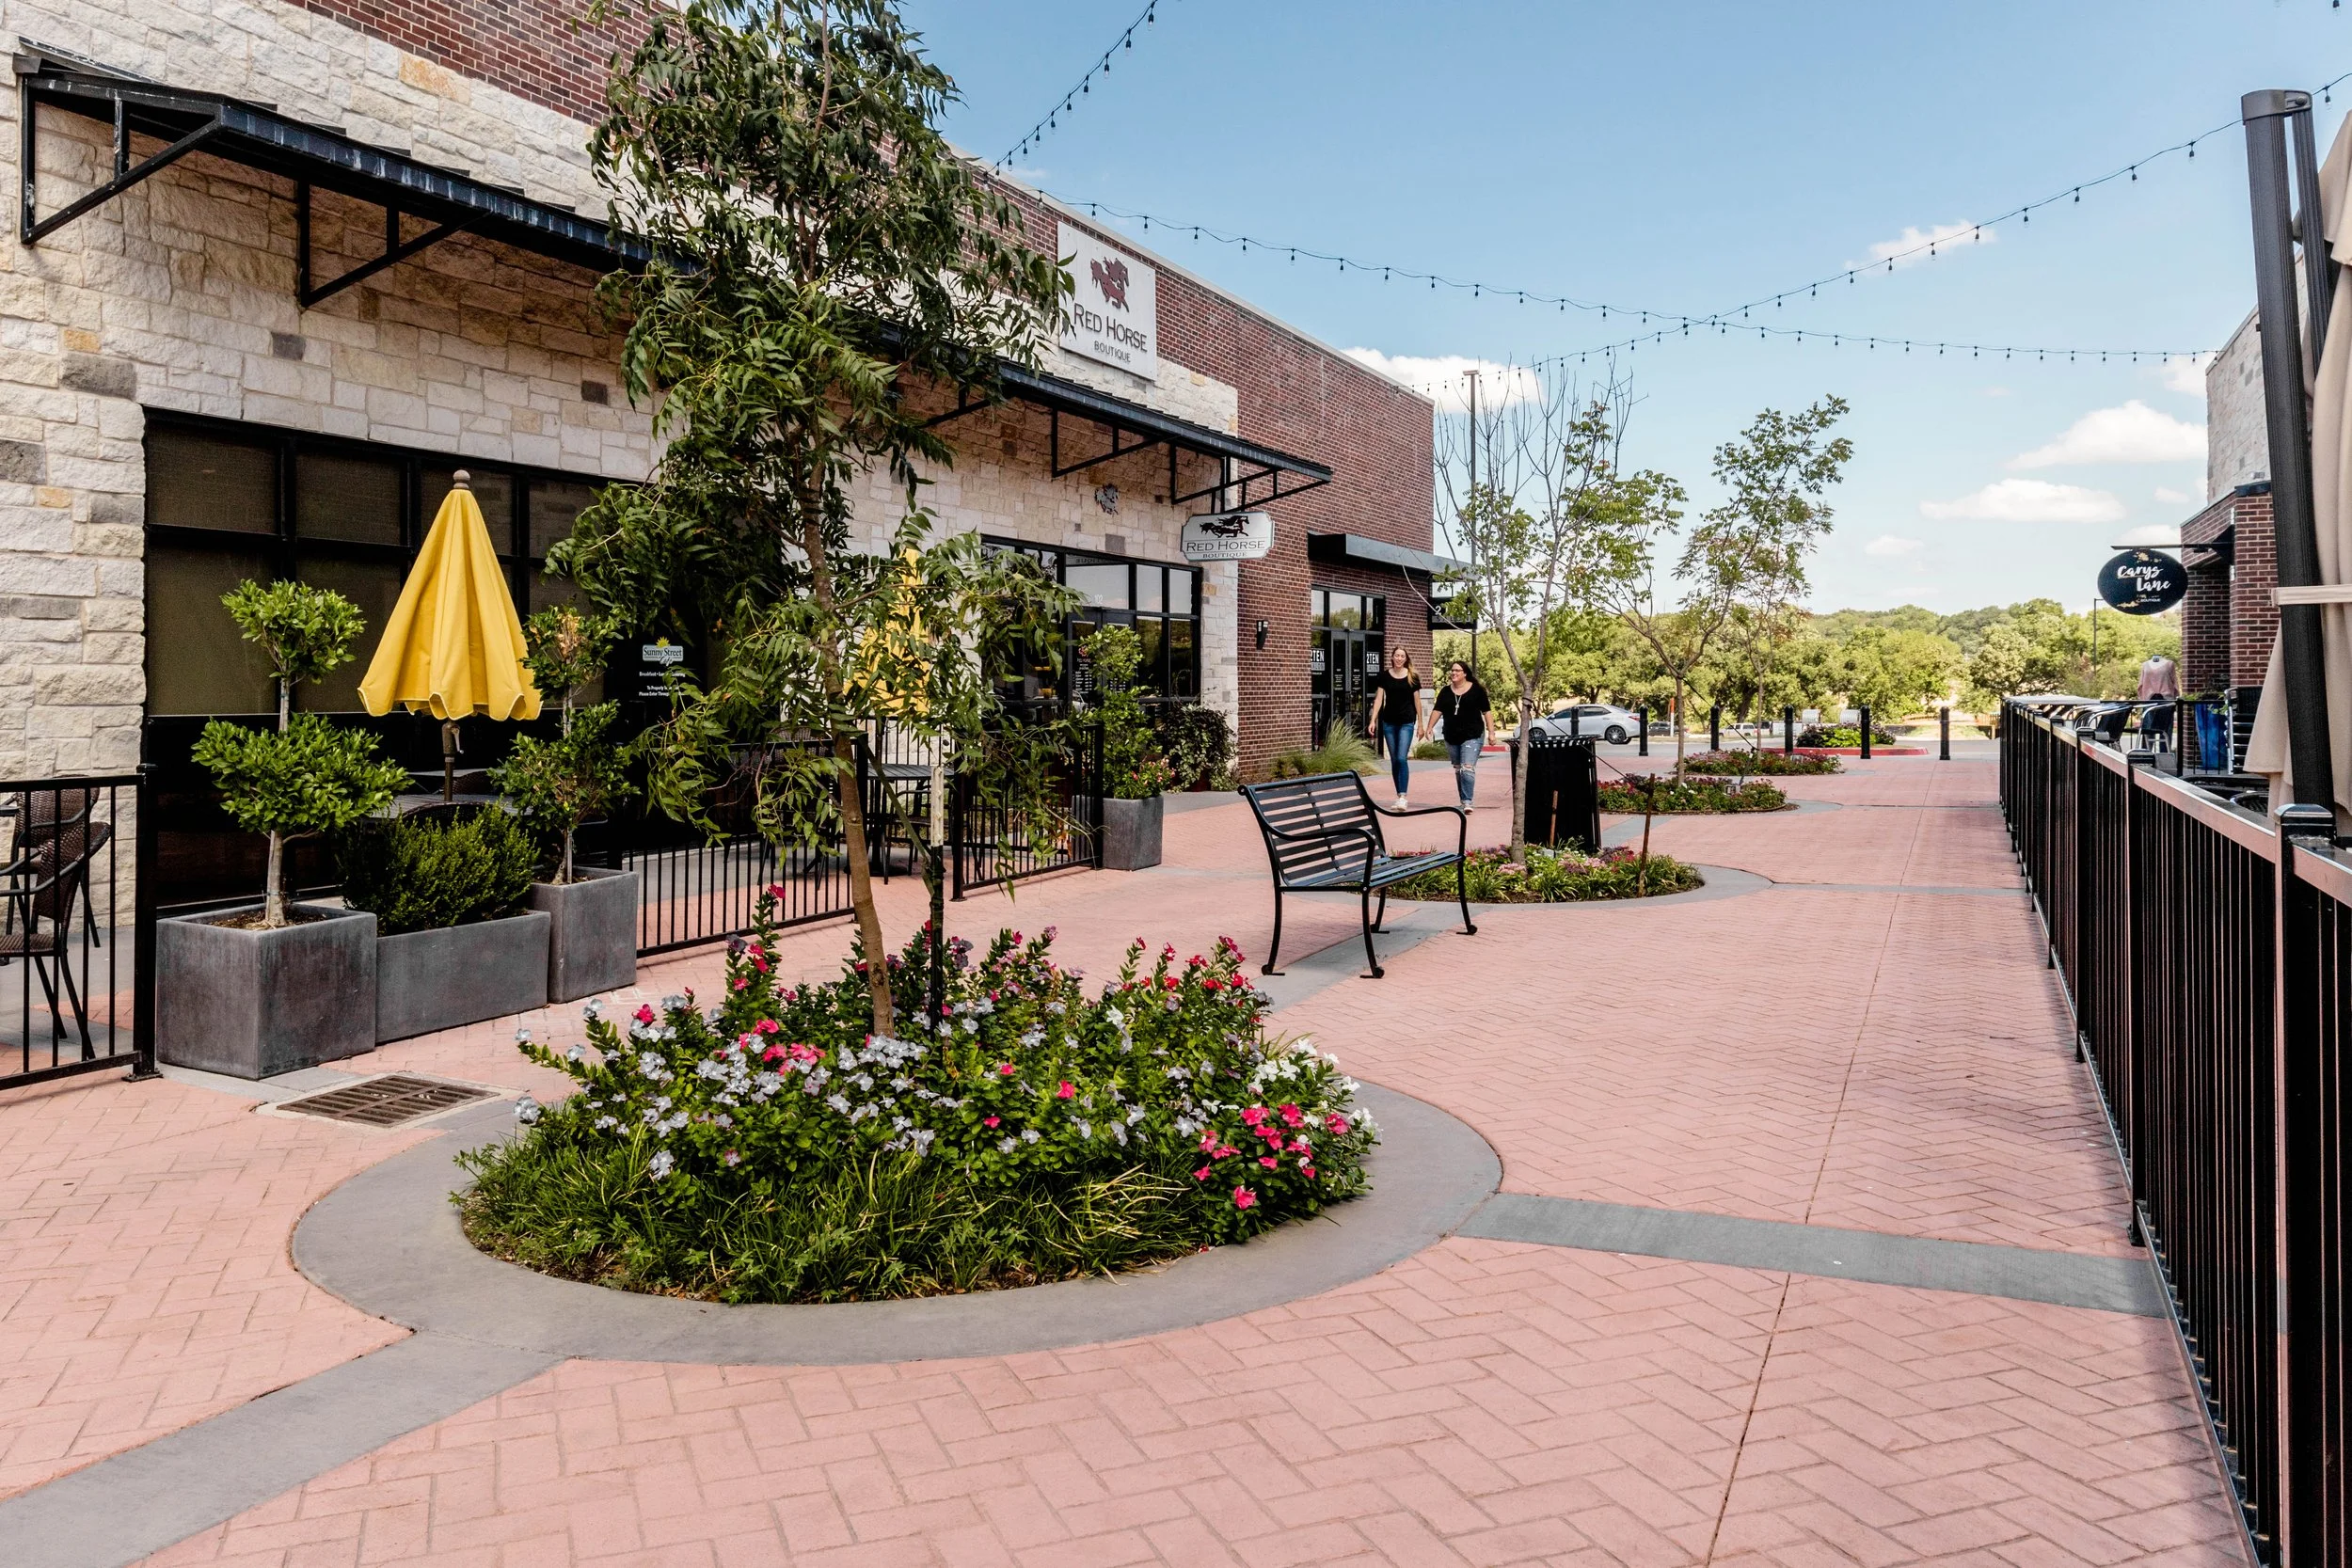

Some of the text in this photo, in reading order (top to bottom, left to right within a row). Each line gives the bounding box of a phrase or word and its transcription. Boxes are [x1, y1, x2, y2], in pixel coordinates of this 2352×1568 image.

[1073, 302, 1148, 353] RED HORSE
[1094, 340, 1131, 363] BOUTIQUE
[1186, 541, 1265, 551] RED HORSE
[2117, 565, 2164, 579] Carys
[2137, 577, 2171, 592] Lane
[644, 647, 682, 657] Sunny Street
[1366, 654, 1379, 664] 2TEN
